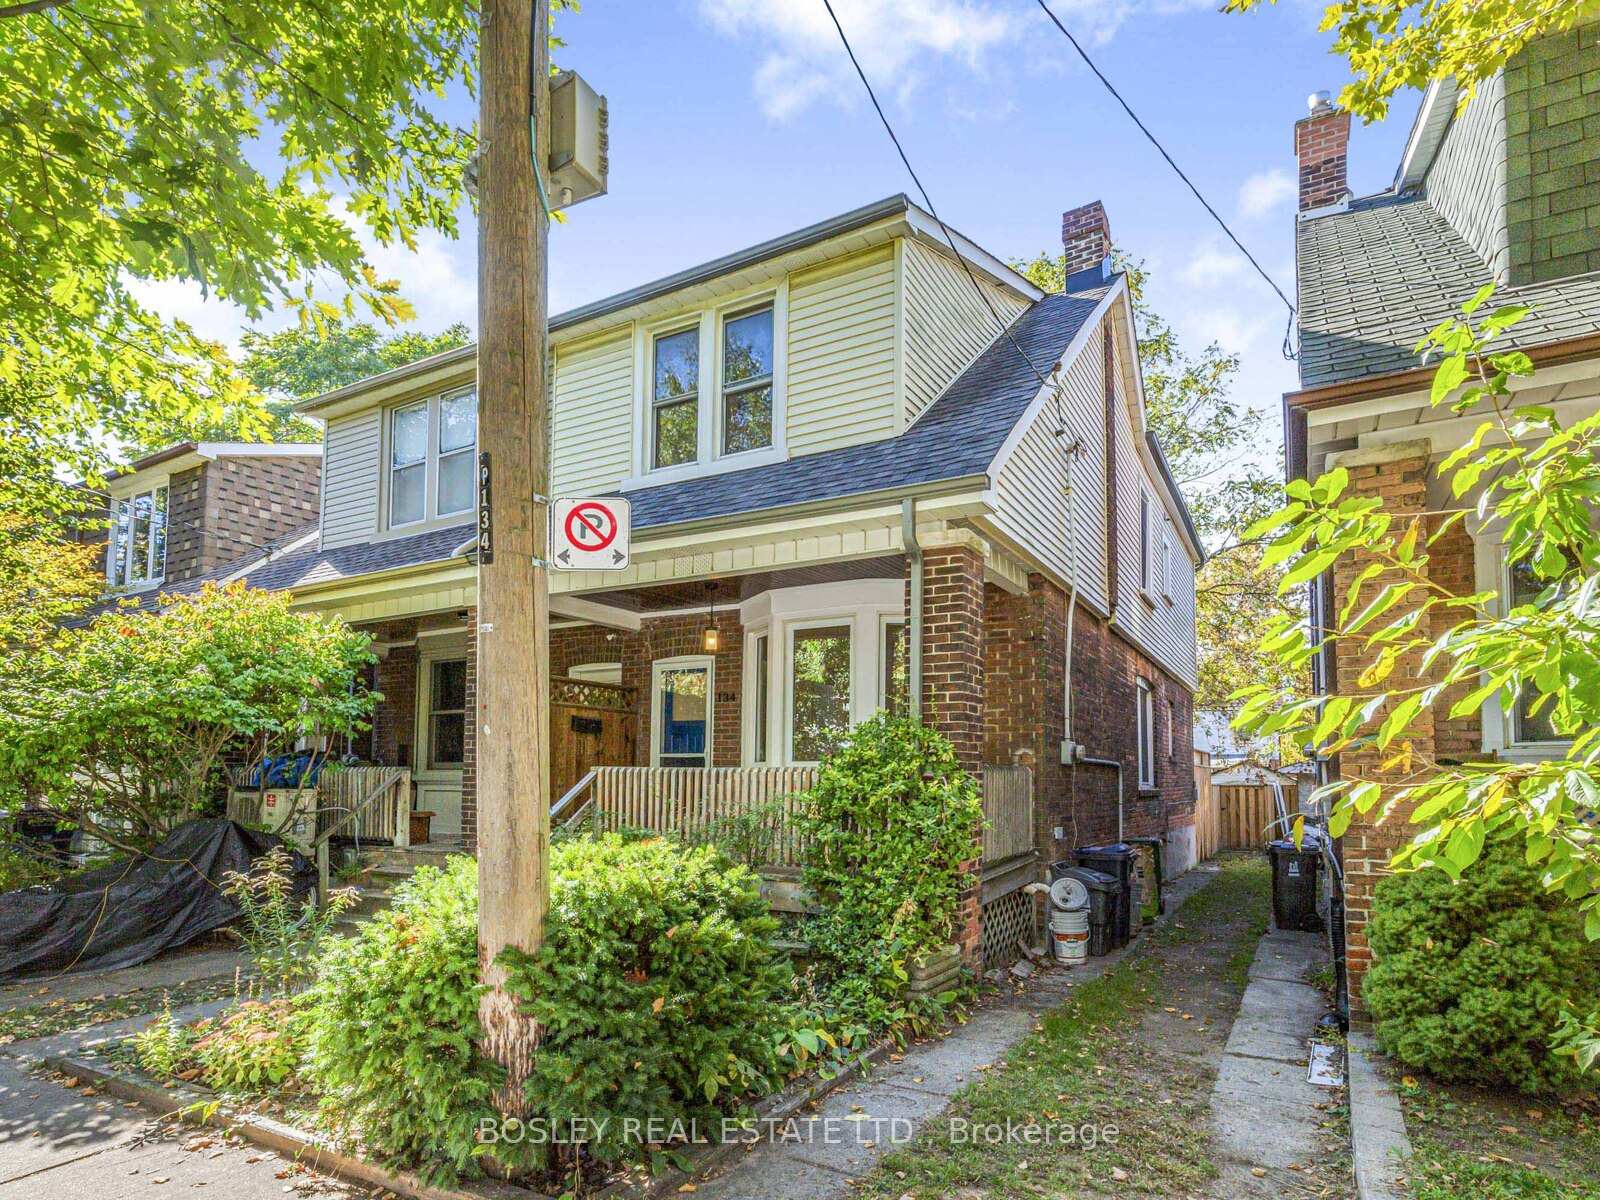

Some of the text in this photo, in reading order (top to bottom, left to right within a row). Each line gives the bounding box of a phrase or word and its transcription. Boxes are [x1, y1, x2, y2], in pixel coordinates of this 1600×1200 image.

[480, 464, 491, 549] P134
[579, 513, 604, 539] P
[718, 693, 736, 702] 134
